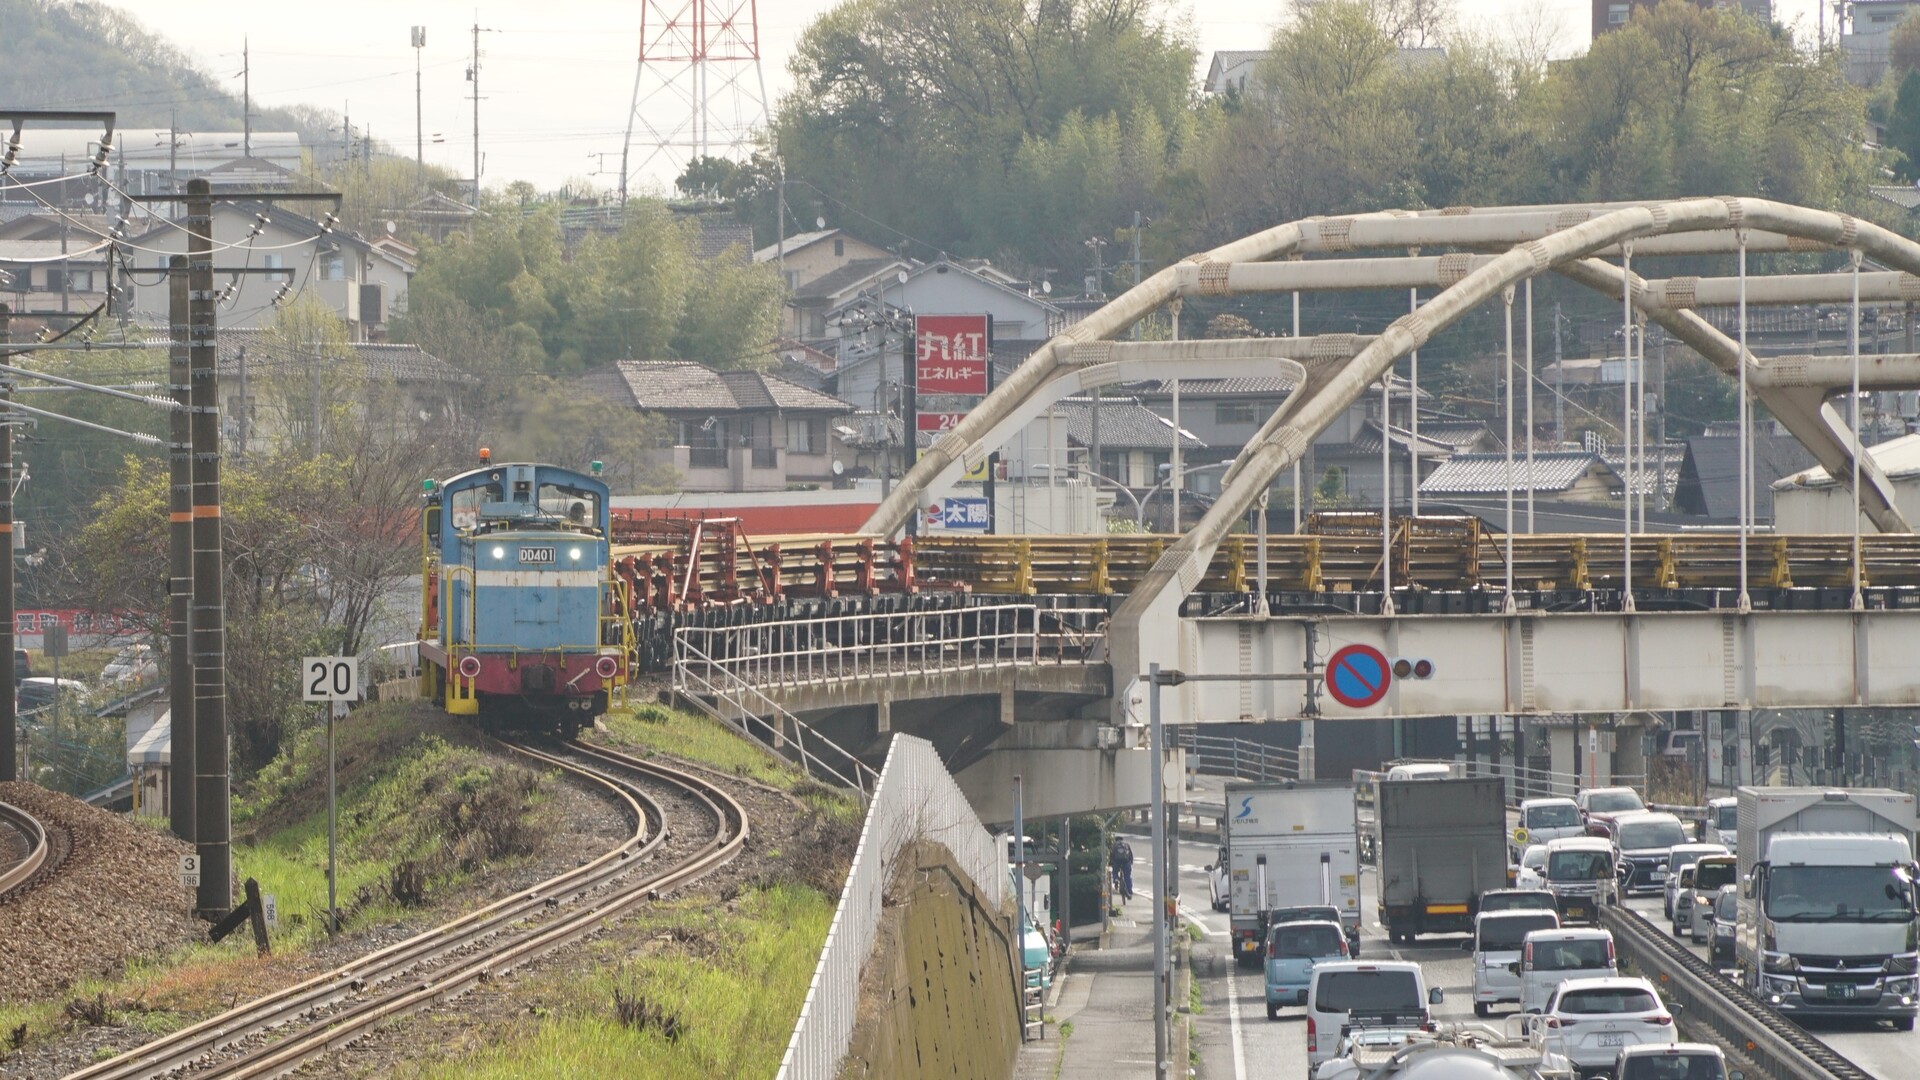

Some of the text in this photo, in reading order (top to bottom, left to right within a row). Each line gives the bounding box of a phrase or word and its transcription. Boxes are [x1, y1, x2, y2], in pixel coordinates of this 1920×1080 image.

[918, 331, 985, 361] 丸紅
[918, 367, 985, 380] エネルギー
[945, 503, 987, 523] 太陽
[520, 549, 553, 561] DD401
[310, 662, 351, 695] 20
[184, 857, 196, 871] 3
[183, 876, 197, 886] 196
